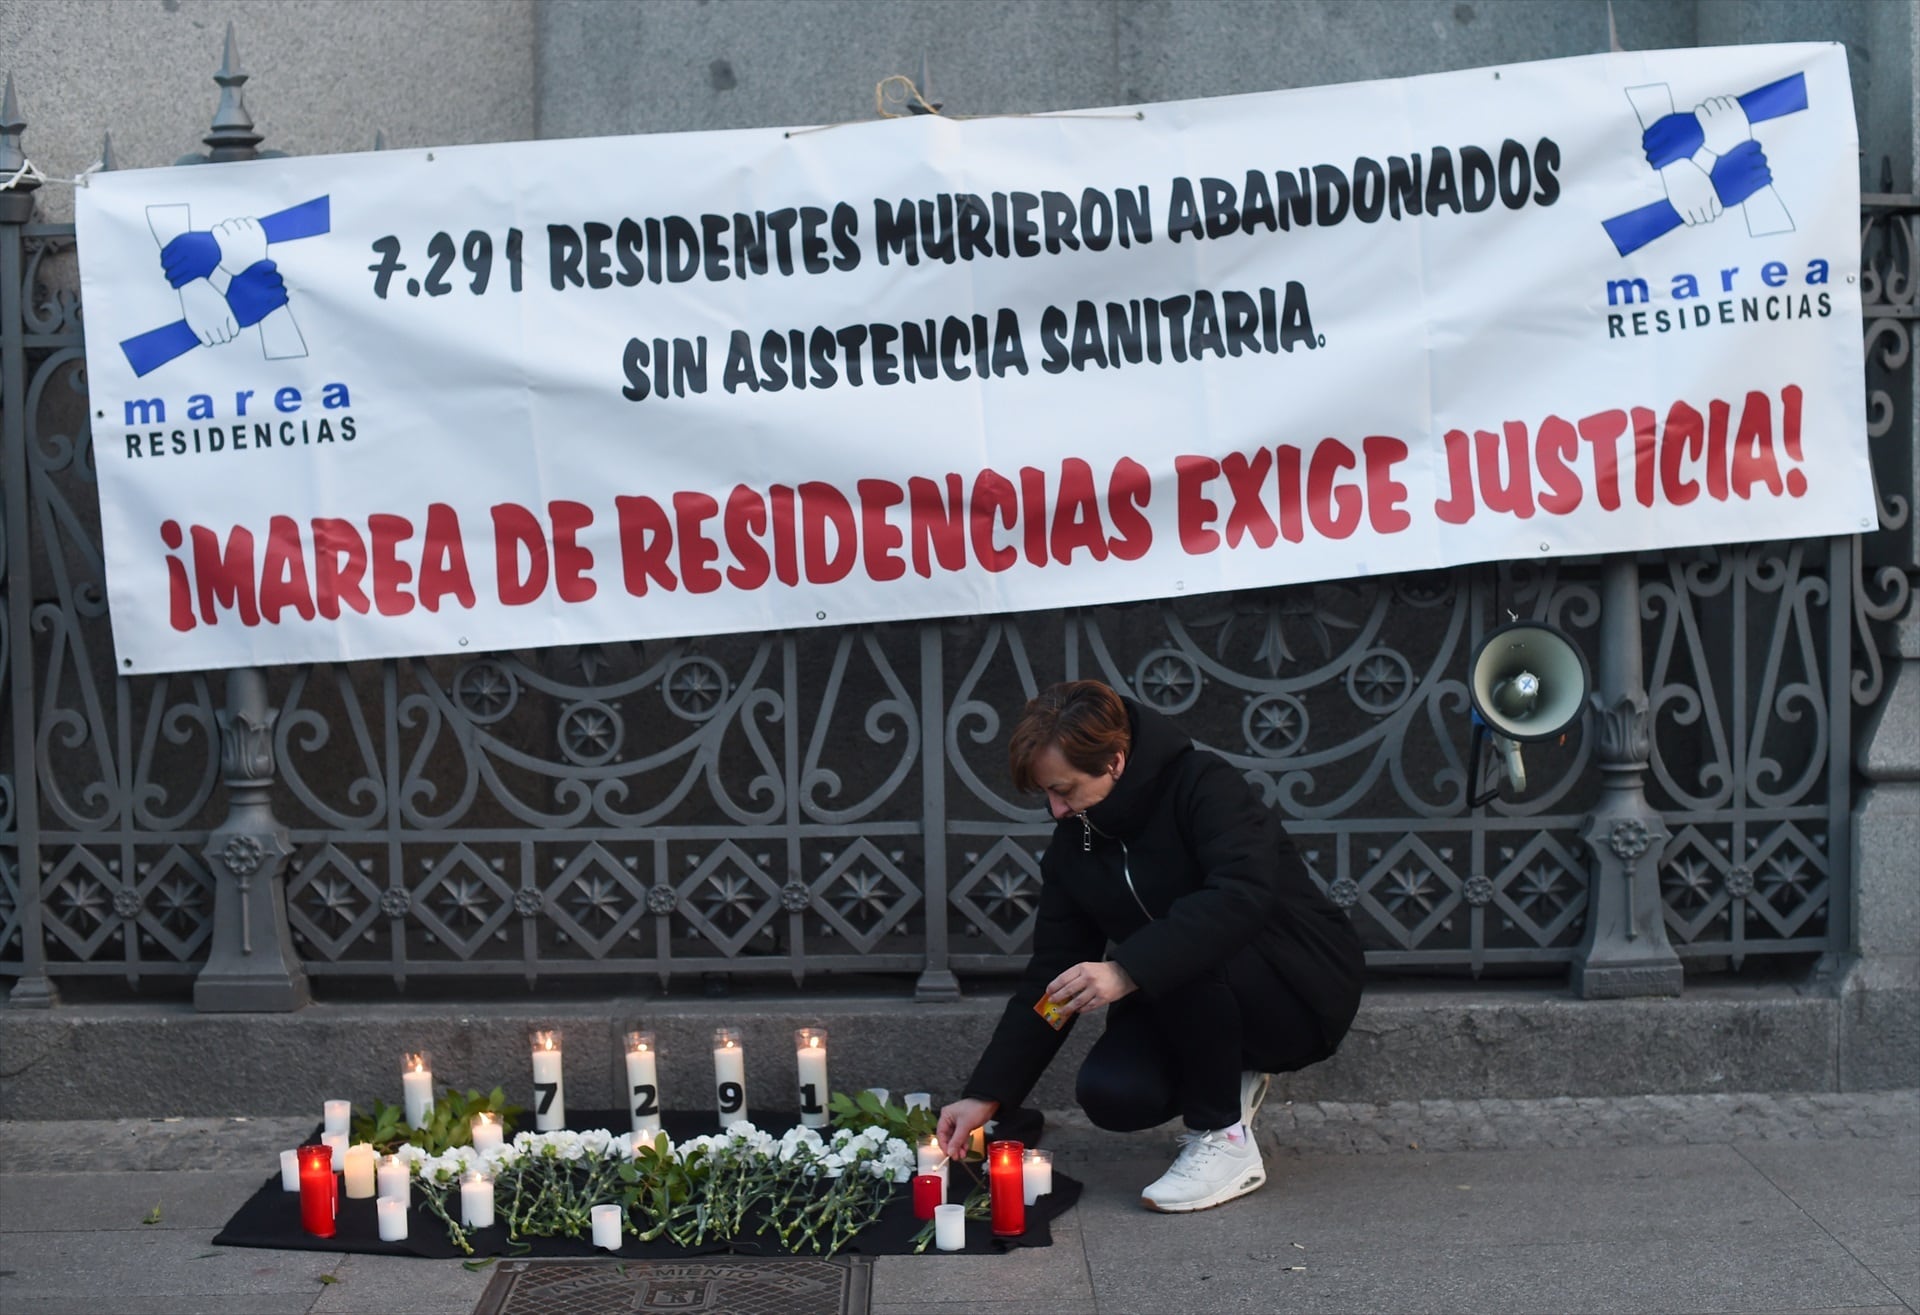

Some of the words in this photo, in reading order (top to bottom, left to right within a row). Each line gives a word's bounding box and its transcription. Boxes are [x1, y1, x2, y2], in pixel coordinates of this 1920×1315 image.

[368, 227, 524, 300] 7.291
[546, 201, 862, 291] RESIDENTES
[873, 185, 1153, 267] MURIERON
[1167, 136, 1561, 244] ABANDONADOS
[1606, 258, 1830, 307] marea
[1607, 292, 1832, 339] RESIDENCIAS
[622, 335, 708, 402] SIN
[723, 307, 1029, 394] ASISTENCIA
[123, 382, 351, 426] marea
[125, 416, 357, 459] RESIDENCIAS
[161, 503, 476, 632] ¡MAREA
[491, 500, 598, 606] DE
[615, 456, 1153, 597] RESIDENCIAS
[1175, 435, 1411, 555] EXIGE
[1434, 384, 1808, 525] JUSTICIA!
[534, 1082, 558, 1115] 7
[633, 1084, 659, 1117] 2
[718, 1081, 743, 1114] 9
[799, 1083, 823, 1114] 1
